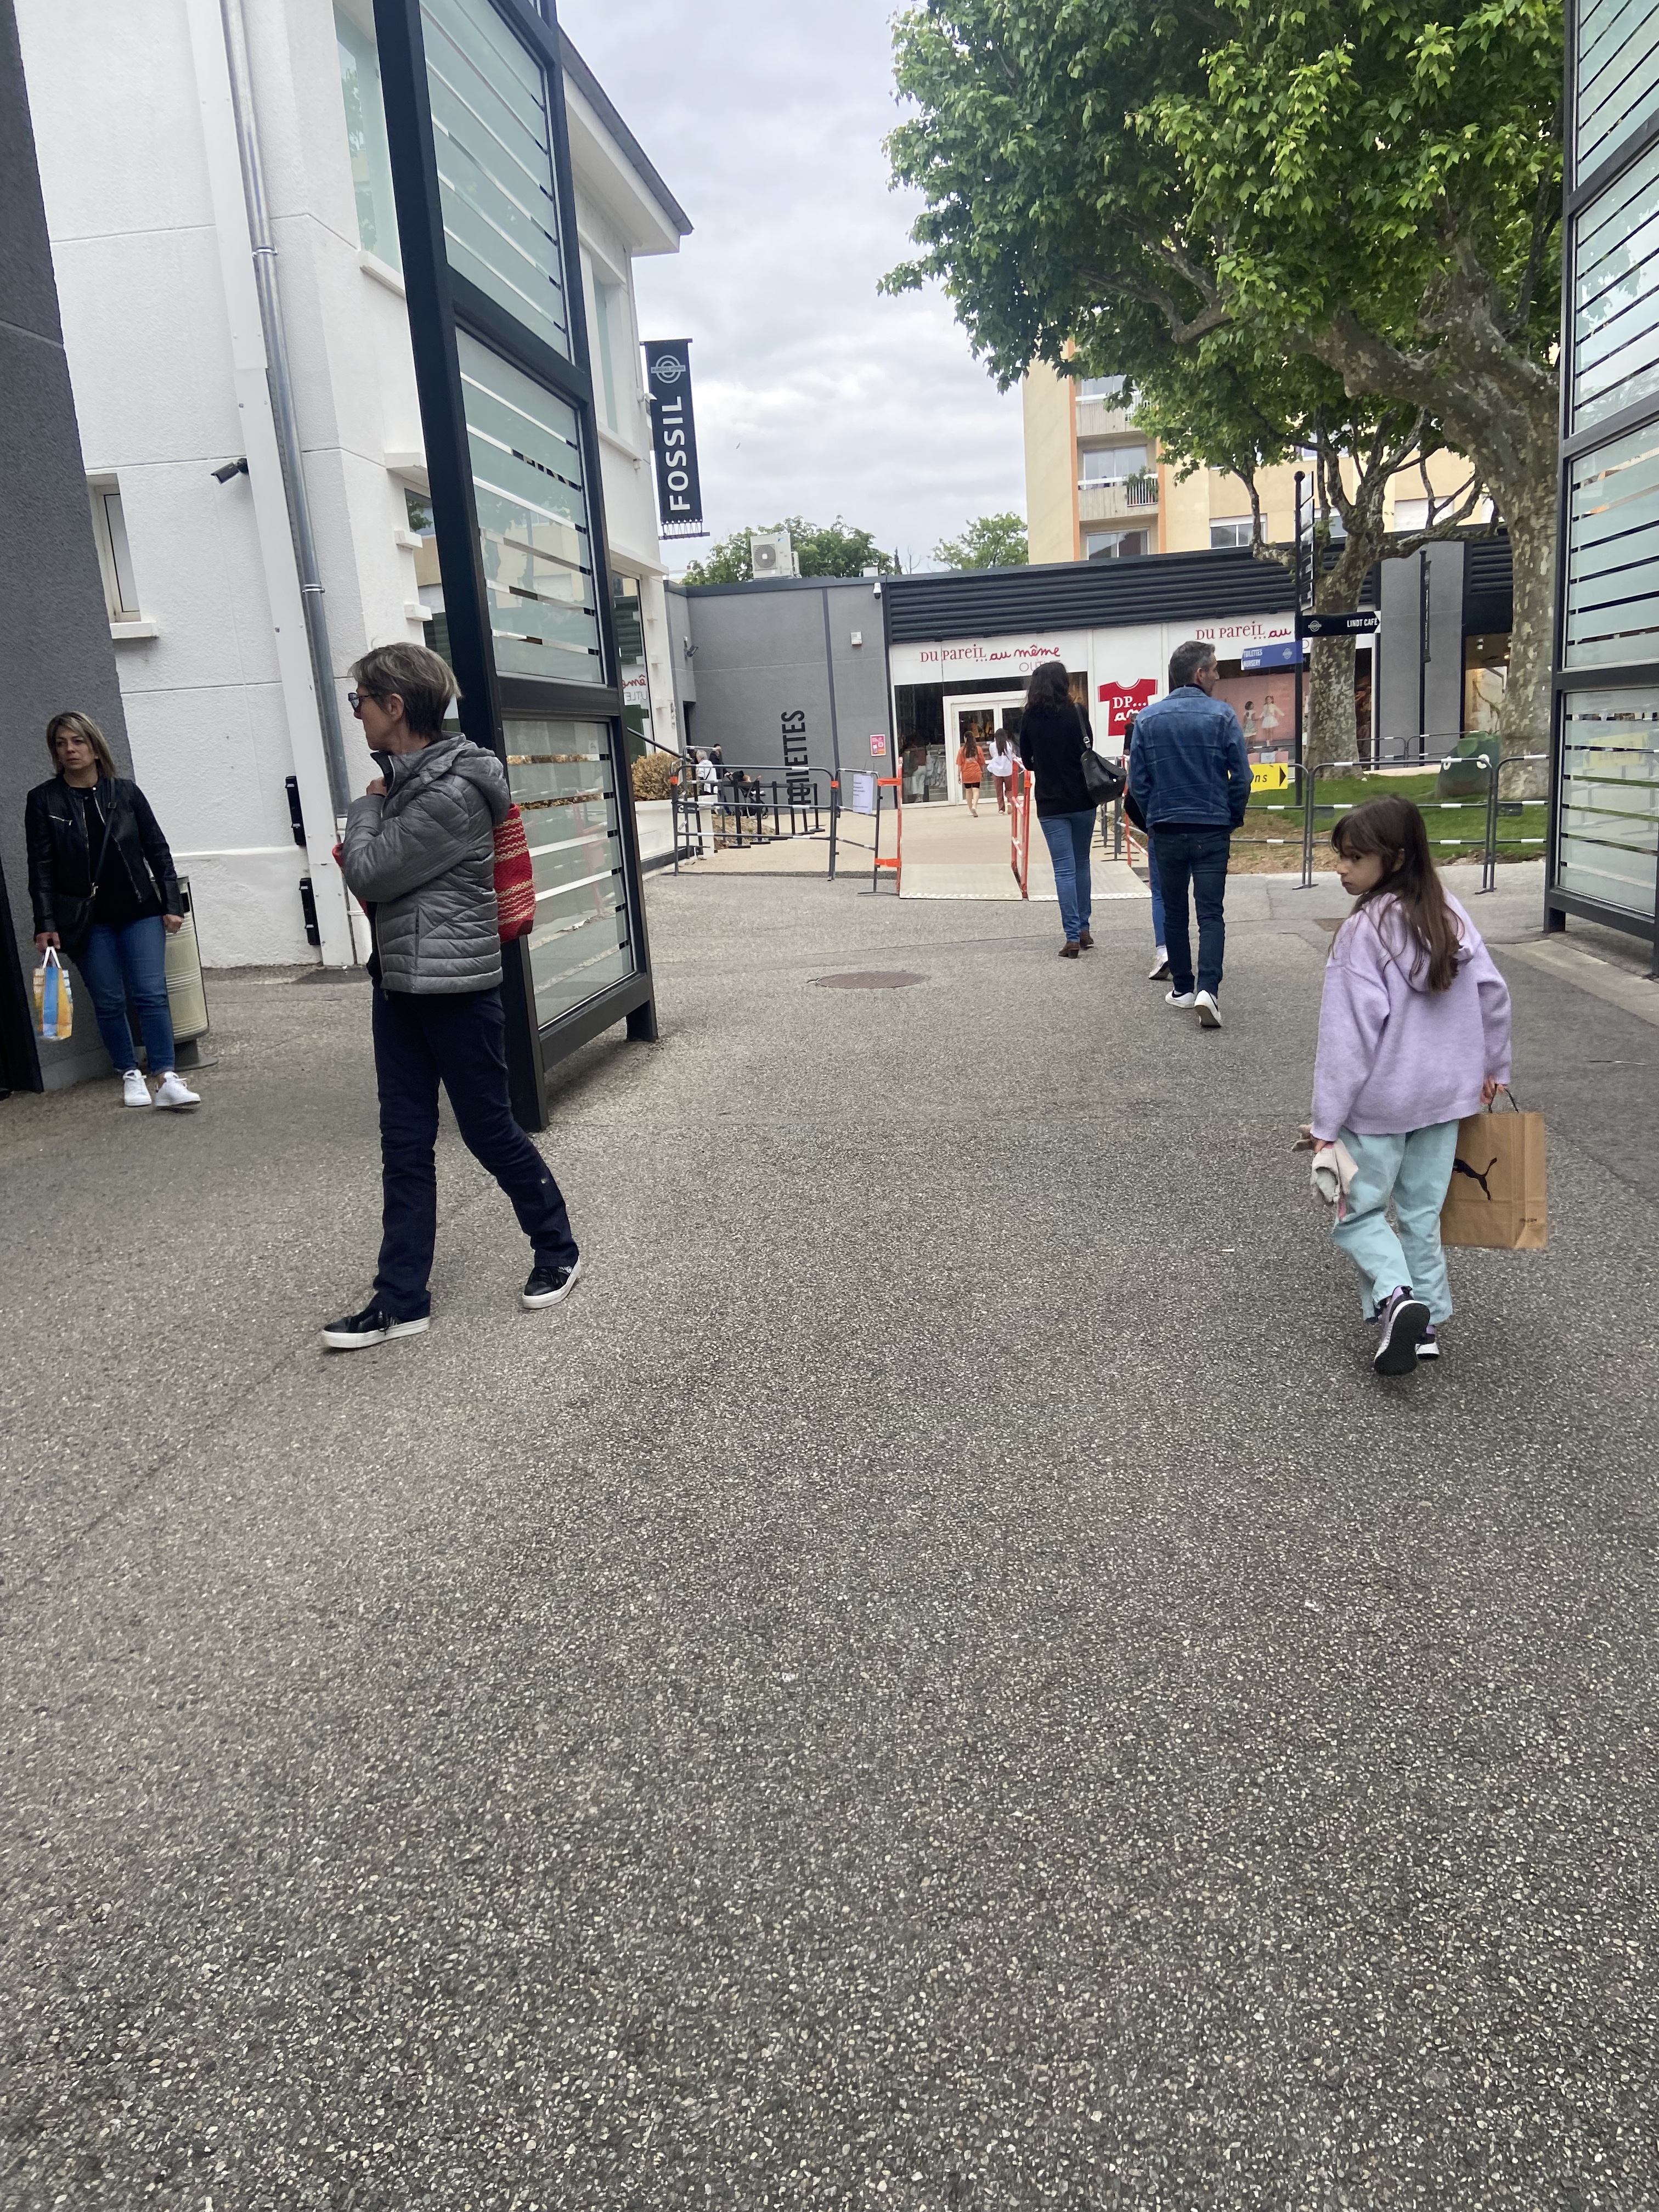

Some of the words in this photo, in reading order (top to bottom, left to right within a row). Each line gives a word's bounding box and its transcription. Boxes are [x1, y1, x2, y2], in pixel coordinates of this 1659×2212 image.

[661, 396, 691, 511] FOSSIL
[1347, 619, 1363, 628] LINDT
[1268, 628, 1291, 638] au
[989, 651, 1011, 661] au
[1013, 644, 1061, 657] même
[781, 710, 811, 805] TOILETTES
